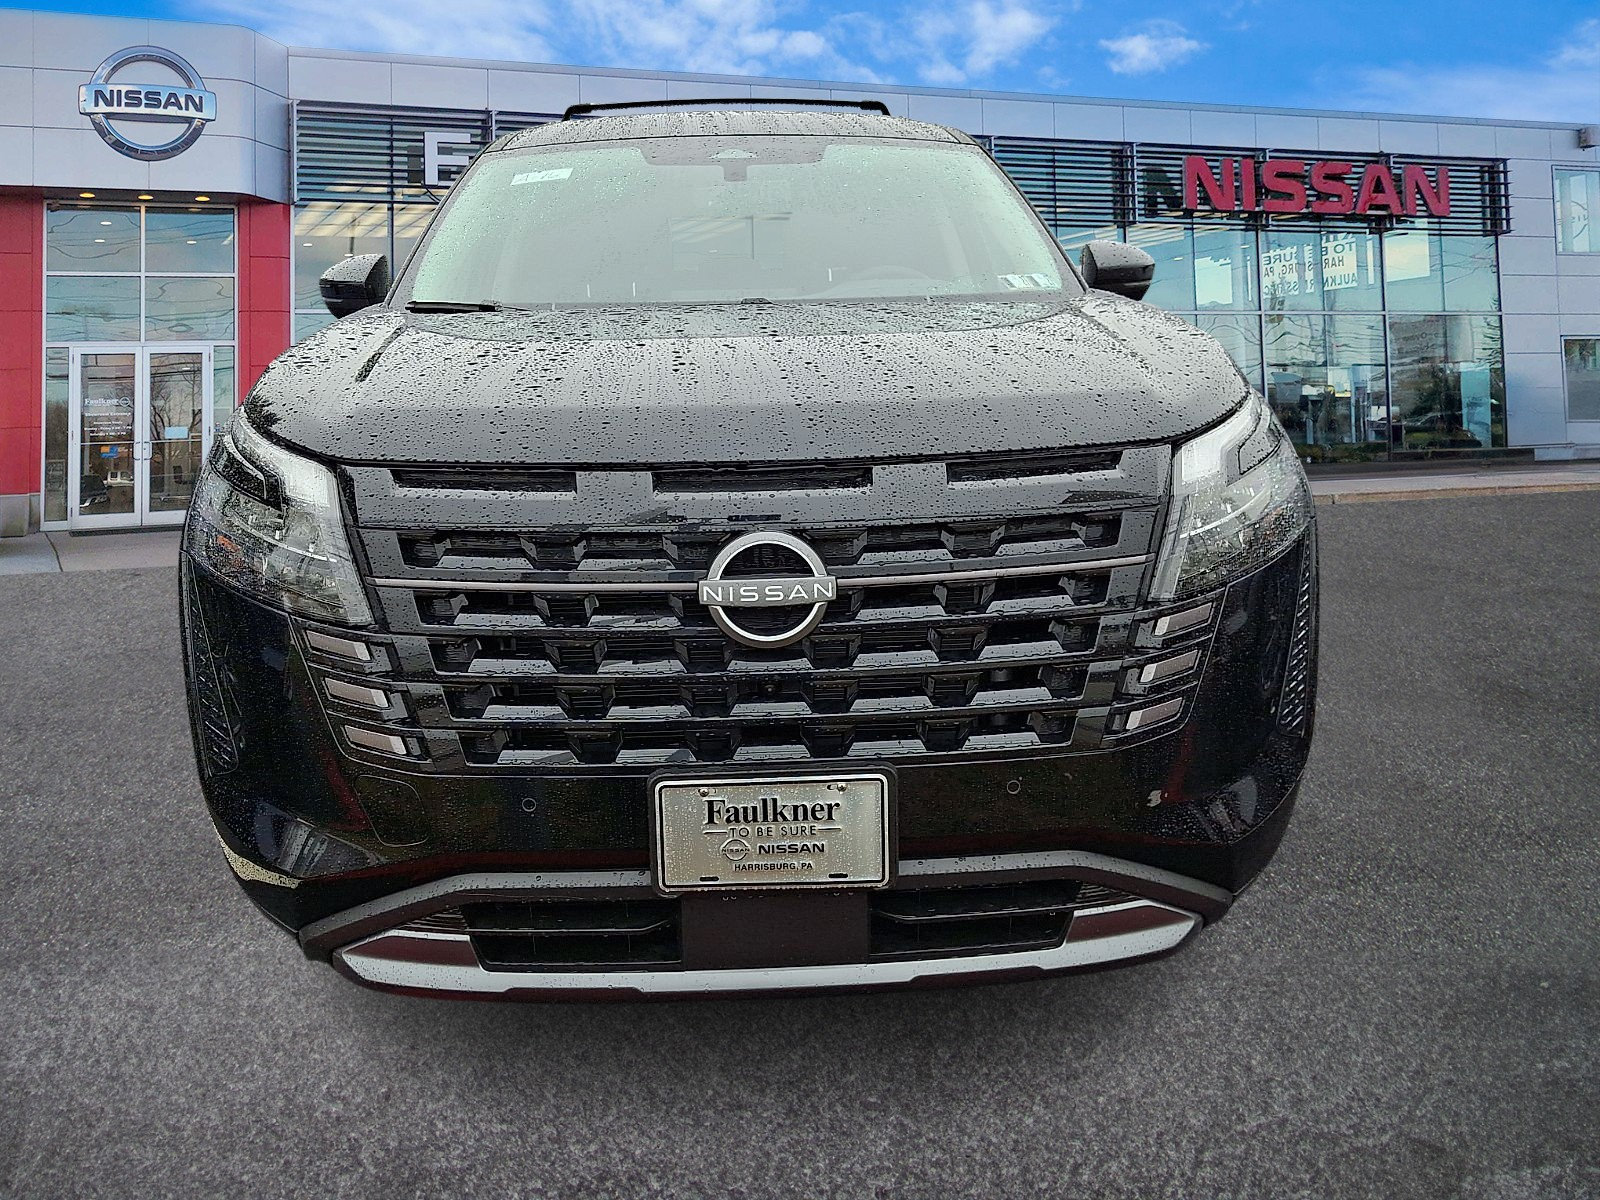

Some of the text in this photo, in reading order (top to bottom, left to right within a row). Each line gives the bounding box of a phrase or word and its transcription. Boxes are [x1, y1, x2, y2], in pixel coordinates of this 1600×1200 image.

[93, 89, 203, 113] NISSAN
[1182, 155, 1450, 217] NISSAN
[702, 581, 833, 602] NISSAN
[704, 797, 841, 825] Faulkner
[729, 825, 817, 838] TO BE SURE
[758, 843, 825, 855] NISSAN
[734, 862, 813, 872] HARRISBURG, PA
